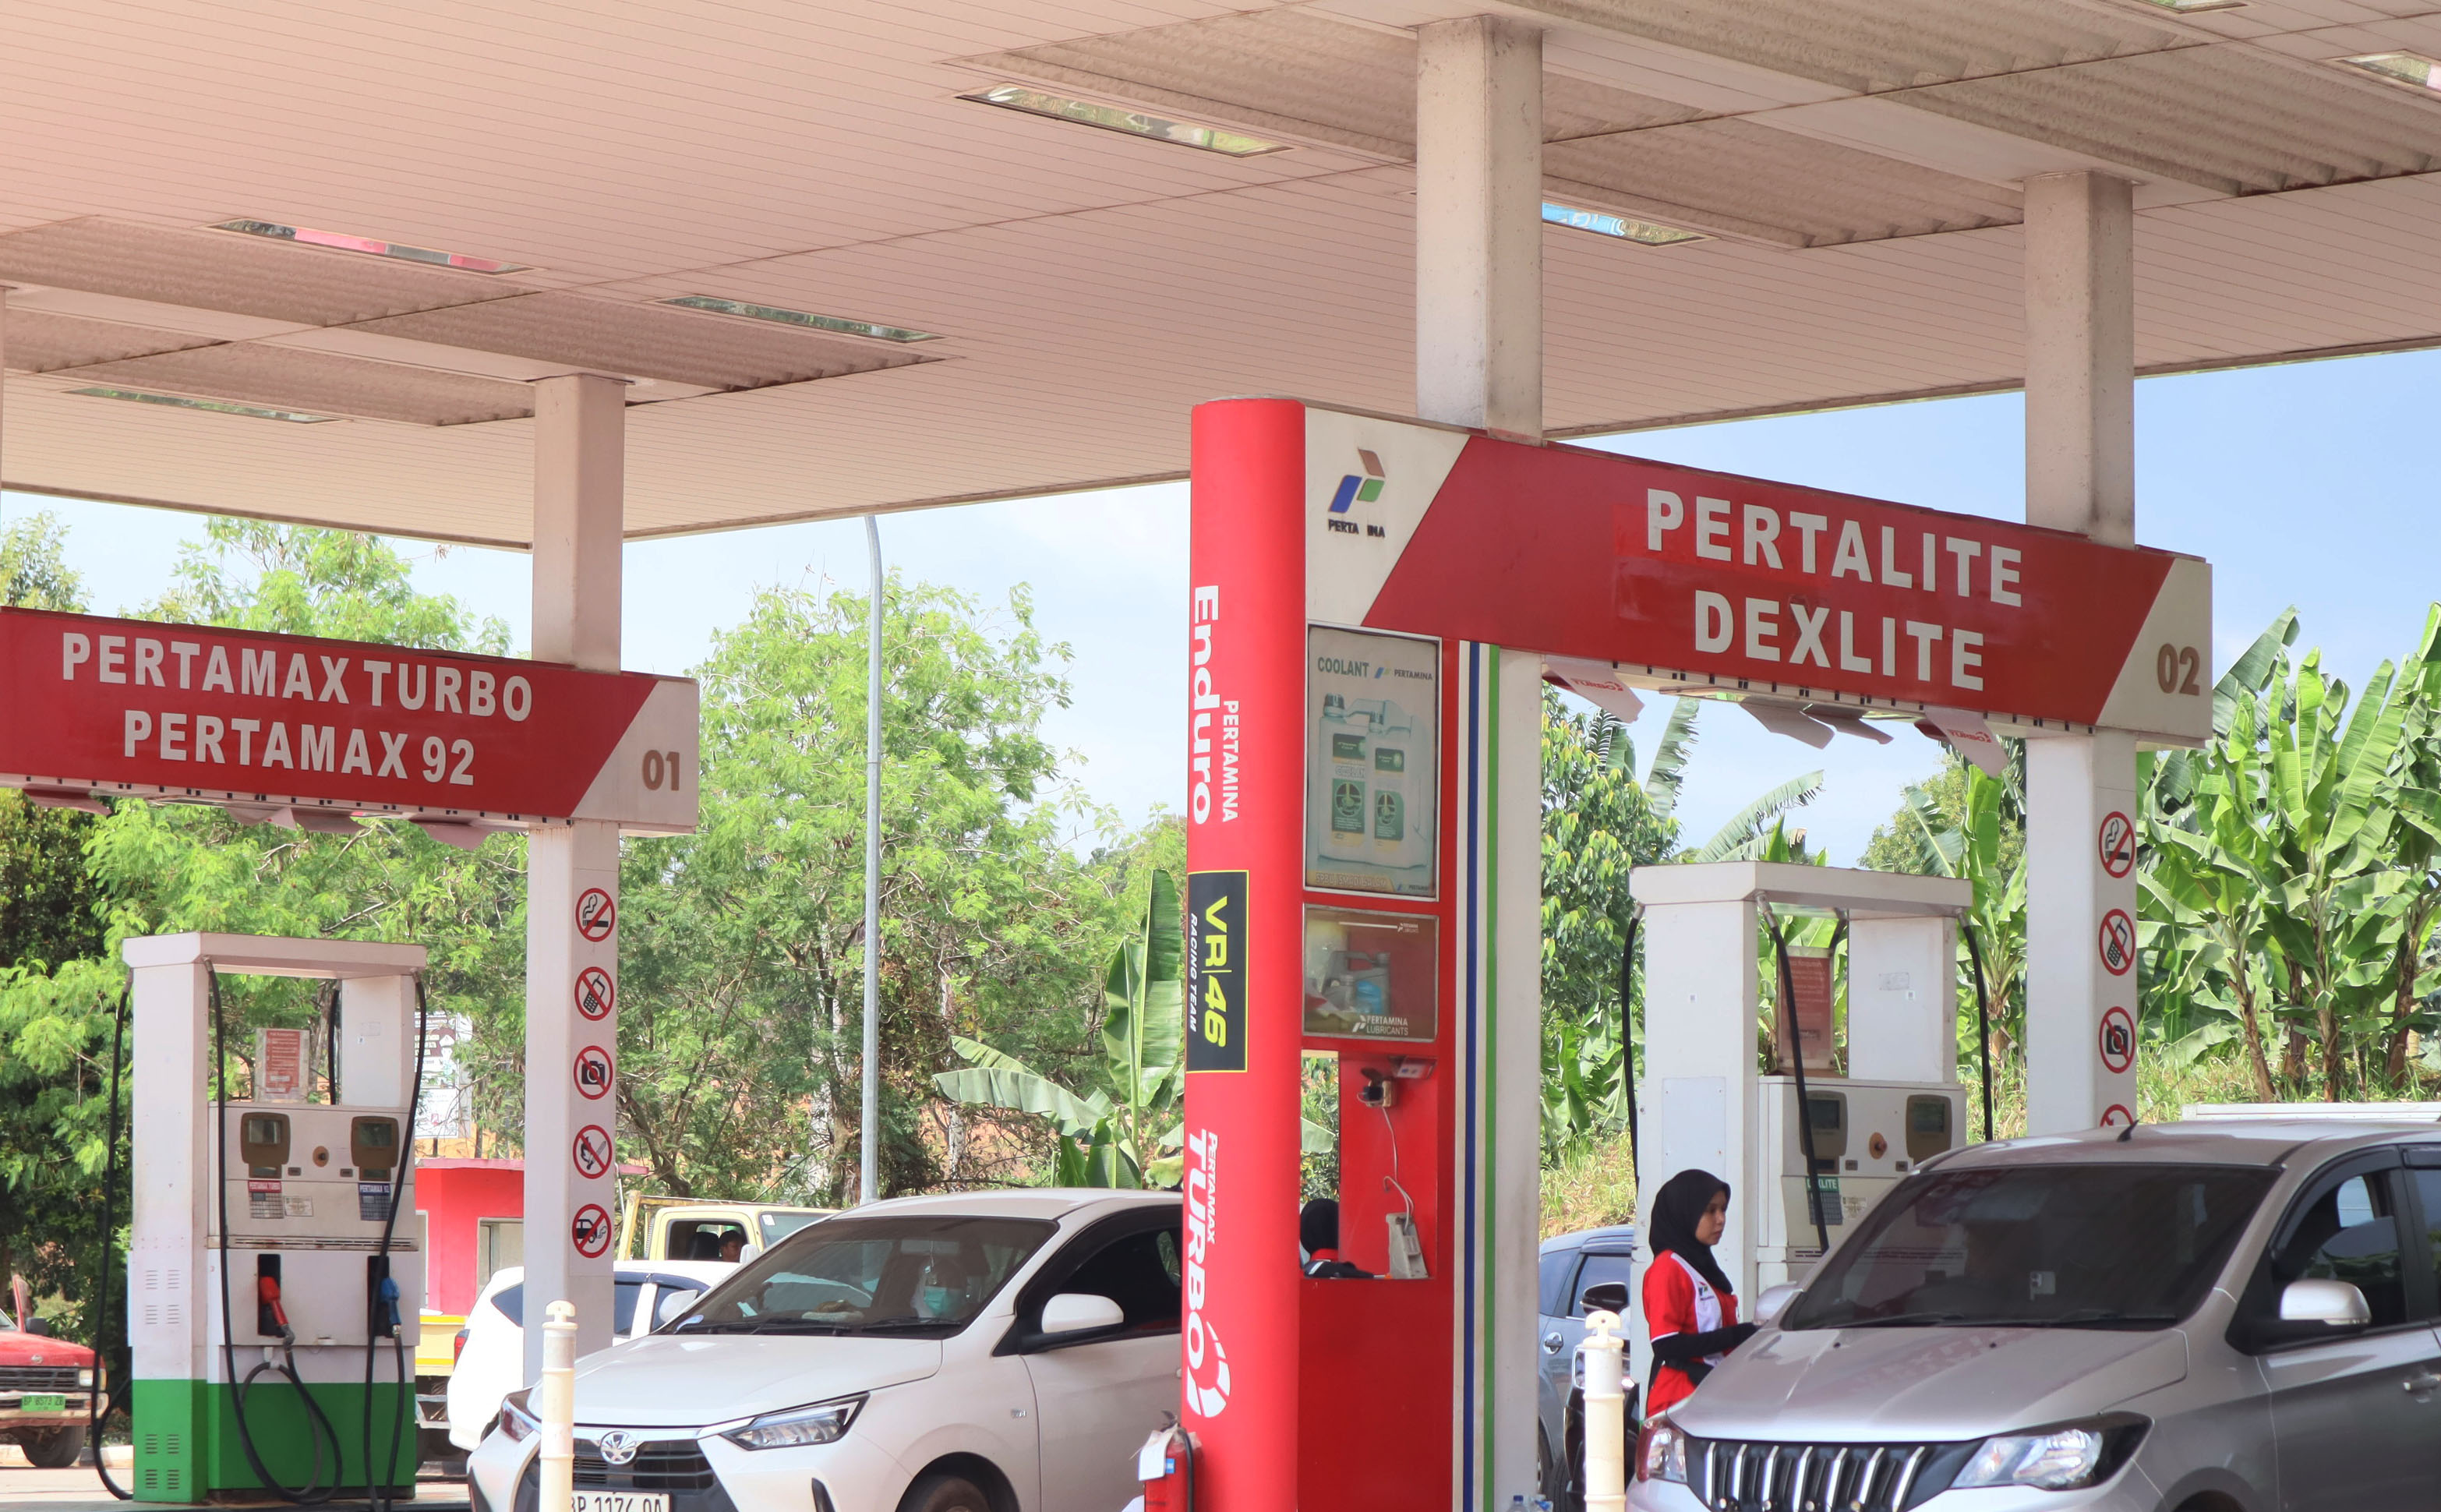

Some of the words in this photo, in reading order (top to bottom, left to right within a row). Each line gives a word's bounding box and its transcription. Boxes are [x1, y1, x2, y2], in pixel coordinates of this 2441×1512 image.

[1648, 488, 2022, 607] PERTALITE
[1317, 656, 1370, 677] COOLANT
[1394, 668, 1433, 681] PERTAMINA
[1695, 590, 1984, 691] DEXLITE
[2157, 644, 2202, 696] 02
[63, 632, 350, 706] PERTAMAX
[363, 660, 532, 722] TURBO
[1193, 585, 1220, 825] Enduro
[125, 710, 408, 779] PERTAMAX
[422, 735, 475, 786] 92
[641, 748, 681, 793] 01
[1222, 700, 1239, 823] PERTAMINA
[1189, 913, 1198, 980] RACING
[1189, 983, 1198, 1033] TEAM
[1365, 1015, 1409, 1026] PERTAMINA
[1365, 1026, 1409, 1037] LUBRICANTS
[1206, 1132, 1218, 1245] PERTAMAX
[1186, 1128, 1207, 1371] TURBO
